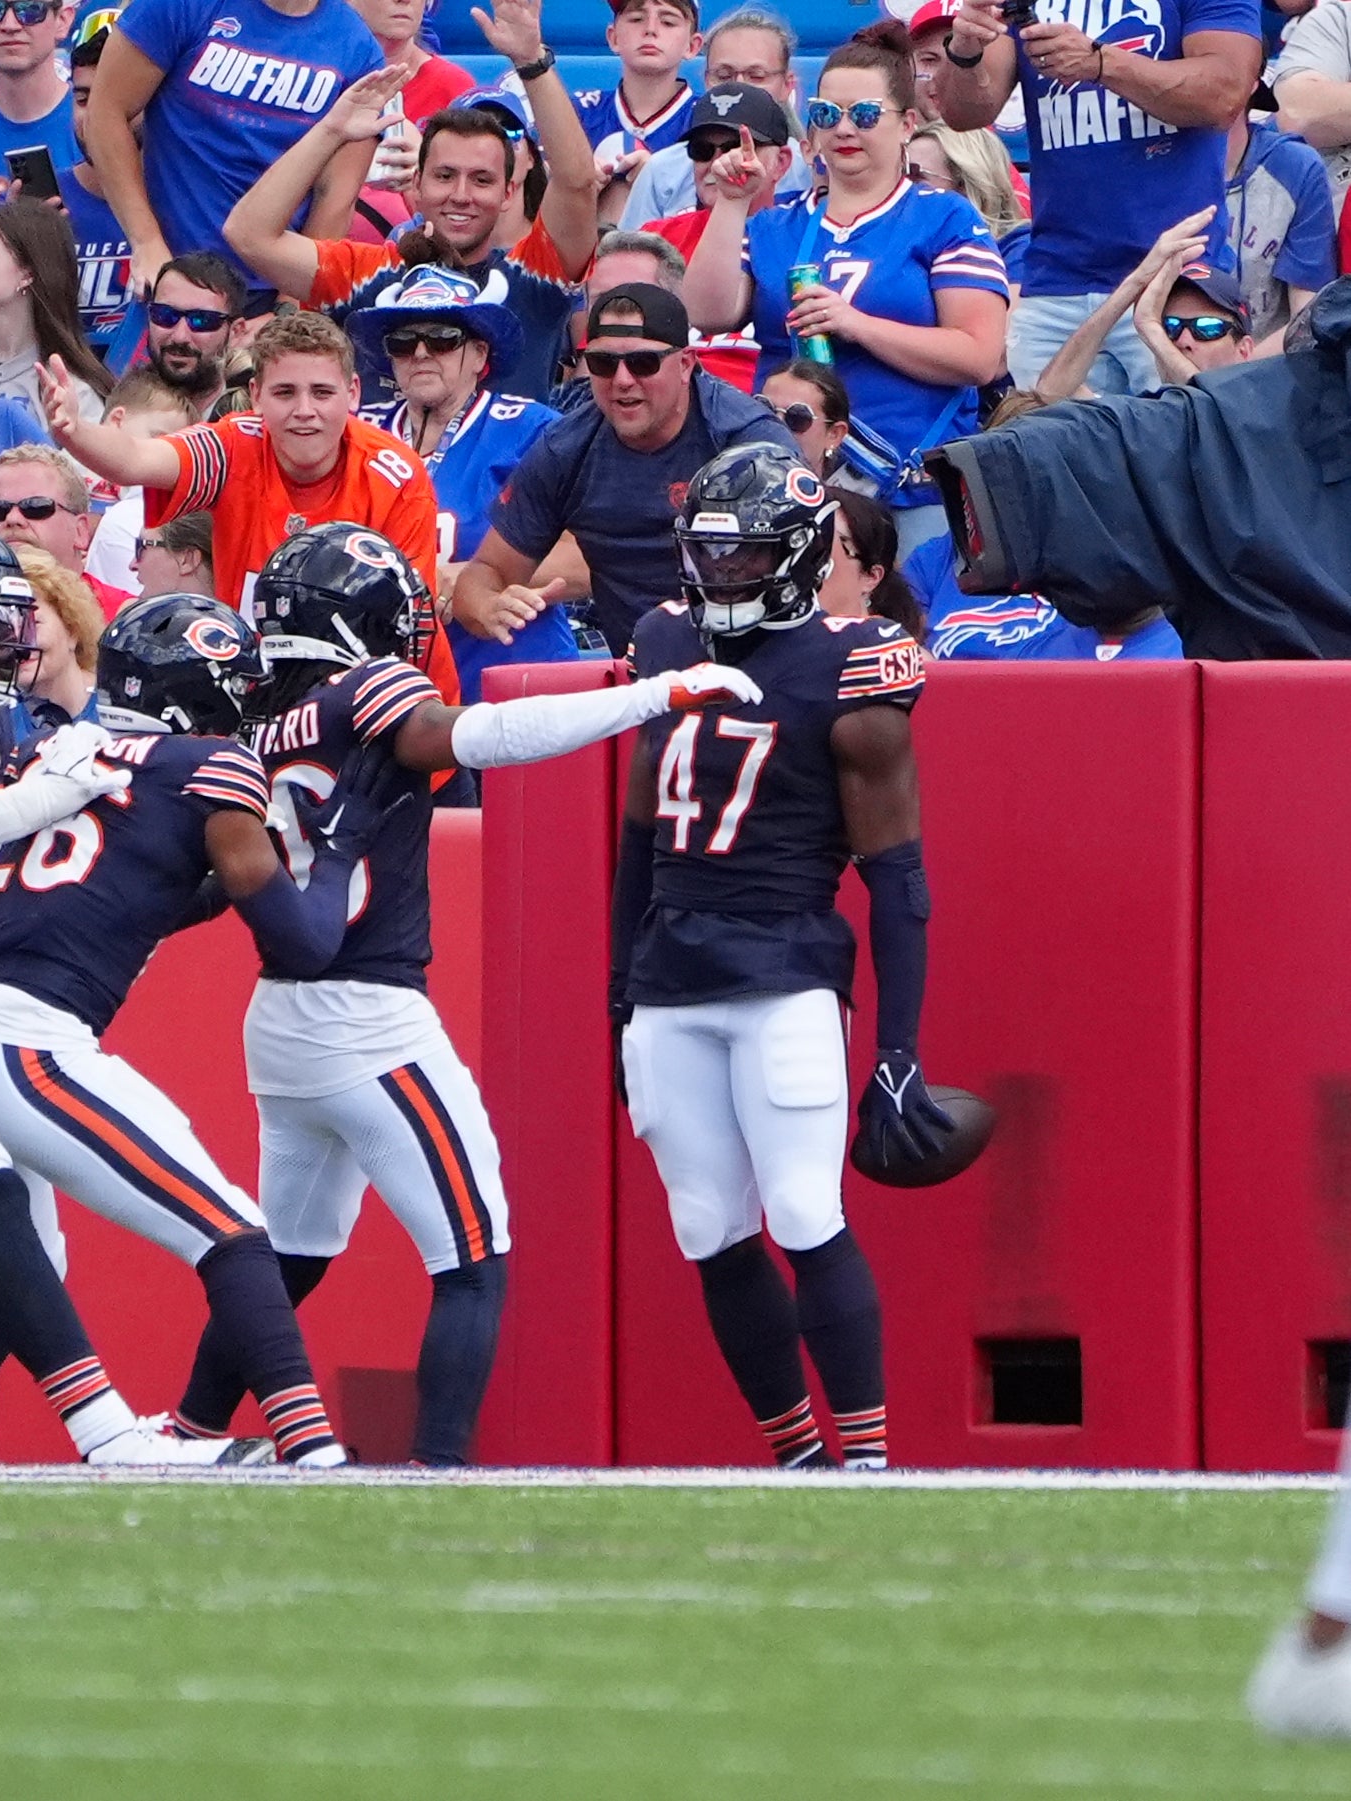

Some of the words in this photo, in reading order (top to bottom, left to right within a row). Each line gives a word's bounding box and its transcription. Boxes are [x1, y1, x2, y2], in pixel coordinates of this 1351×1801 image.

[188, 41, 337, 114] BUFFALO
[367, 449, 414, 489] 18
[879, 645, 920, 684] GSH
[655, 711, 779, 854] 47
